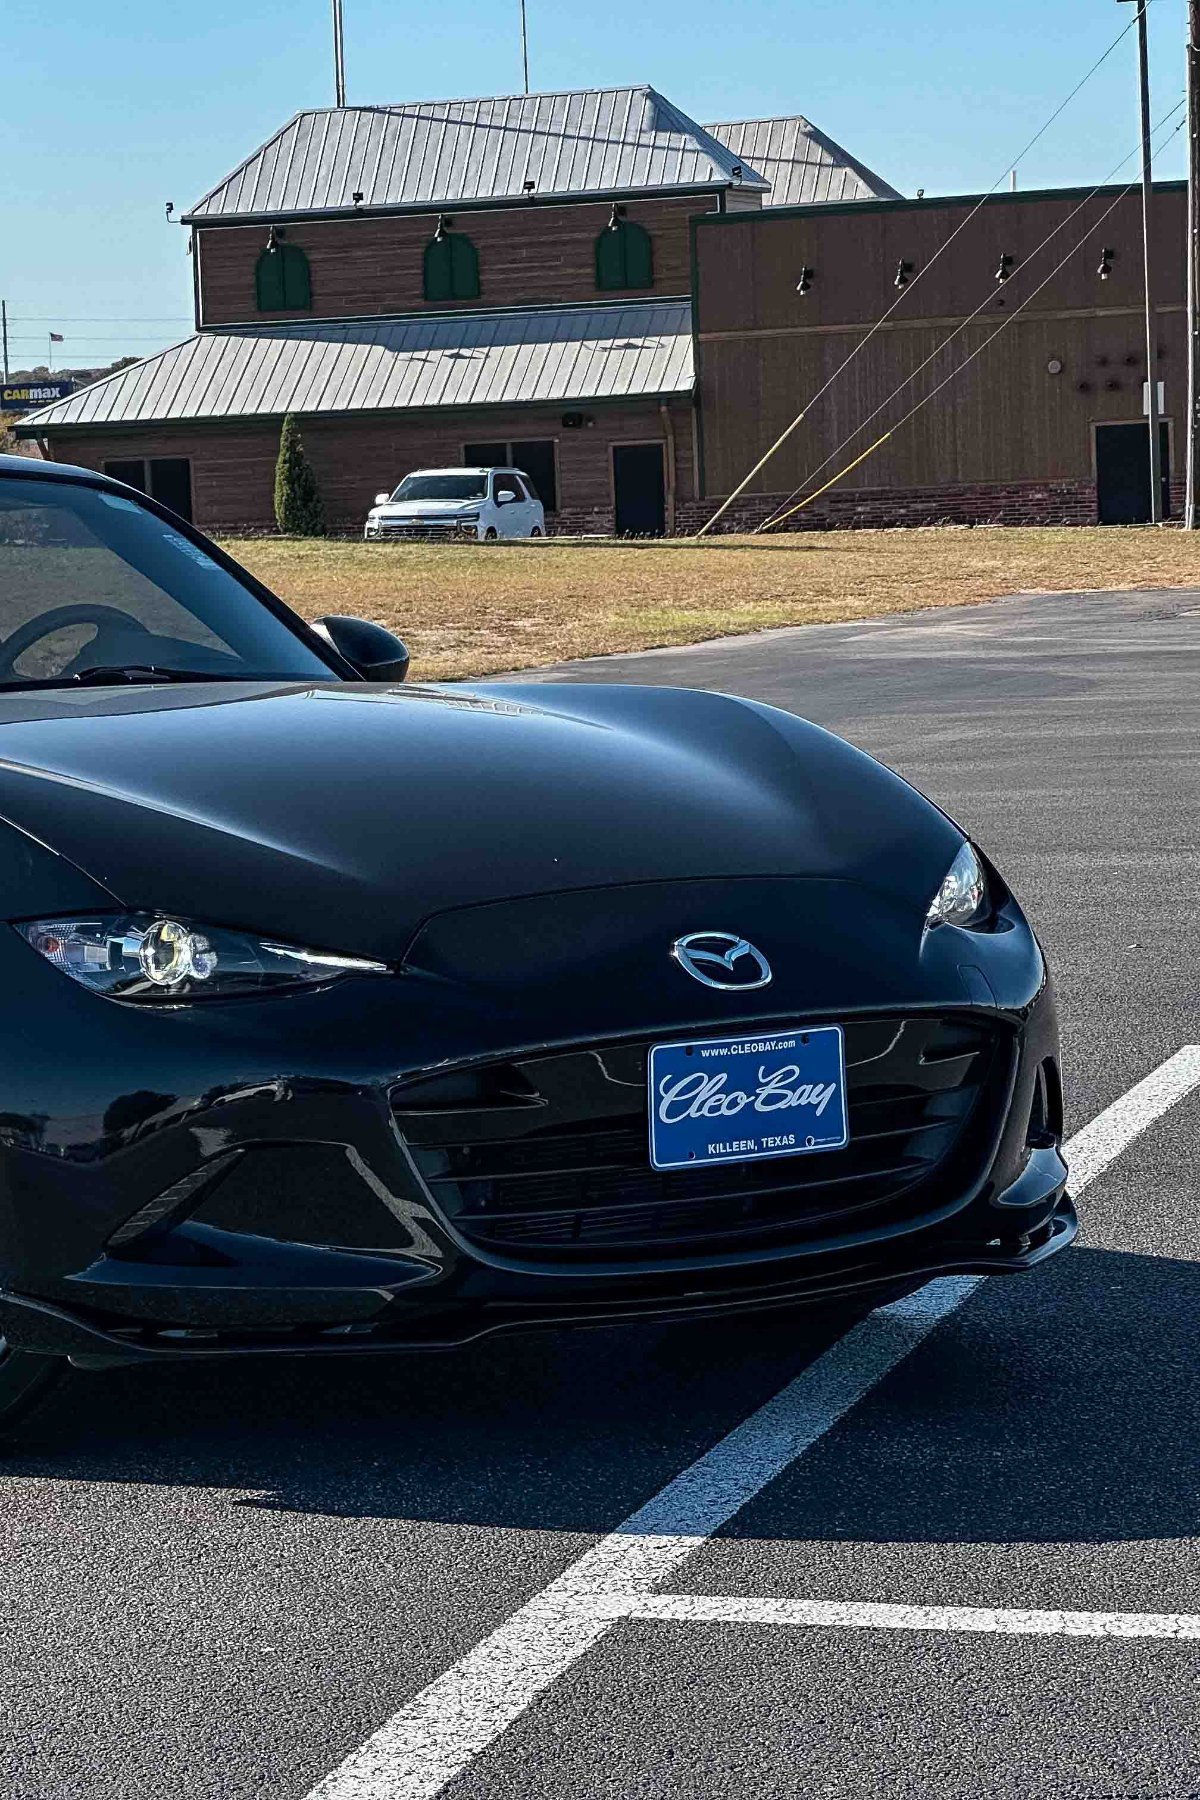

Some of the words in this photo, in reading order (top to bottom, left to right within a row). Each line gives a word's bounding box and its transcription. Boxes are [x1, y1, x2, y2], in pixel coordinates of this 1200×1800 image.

[701, 1040, 796, 1058] www.CLEOBAY.com
[659, 1072, 755, 1124] Cleo
[754, 1065, 836, 1117] Bay
[707, 1140, 758, 1155] KILLEEN,
[761, 1134, 796, 1149] TEXAS
